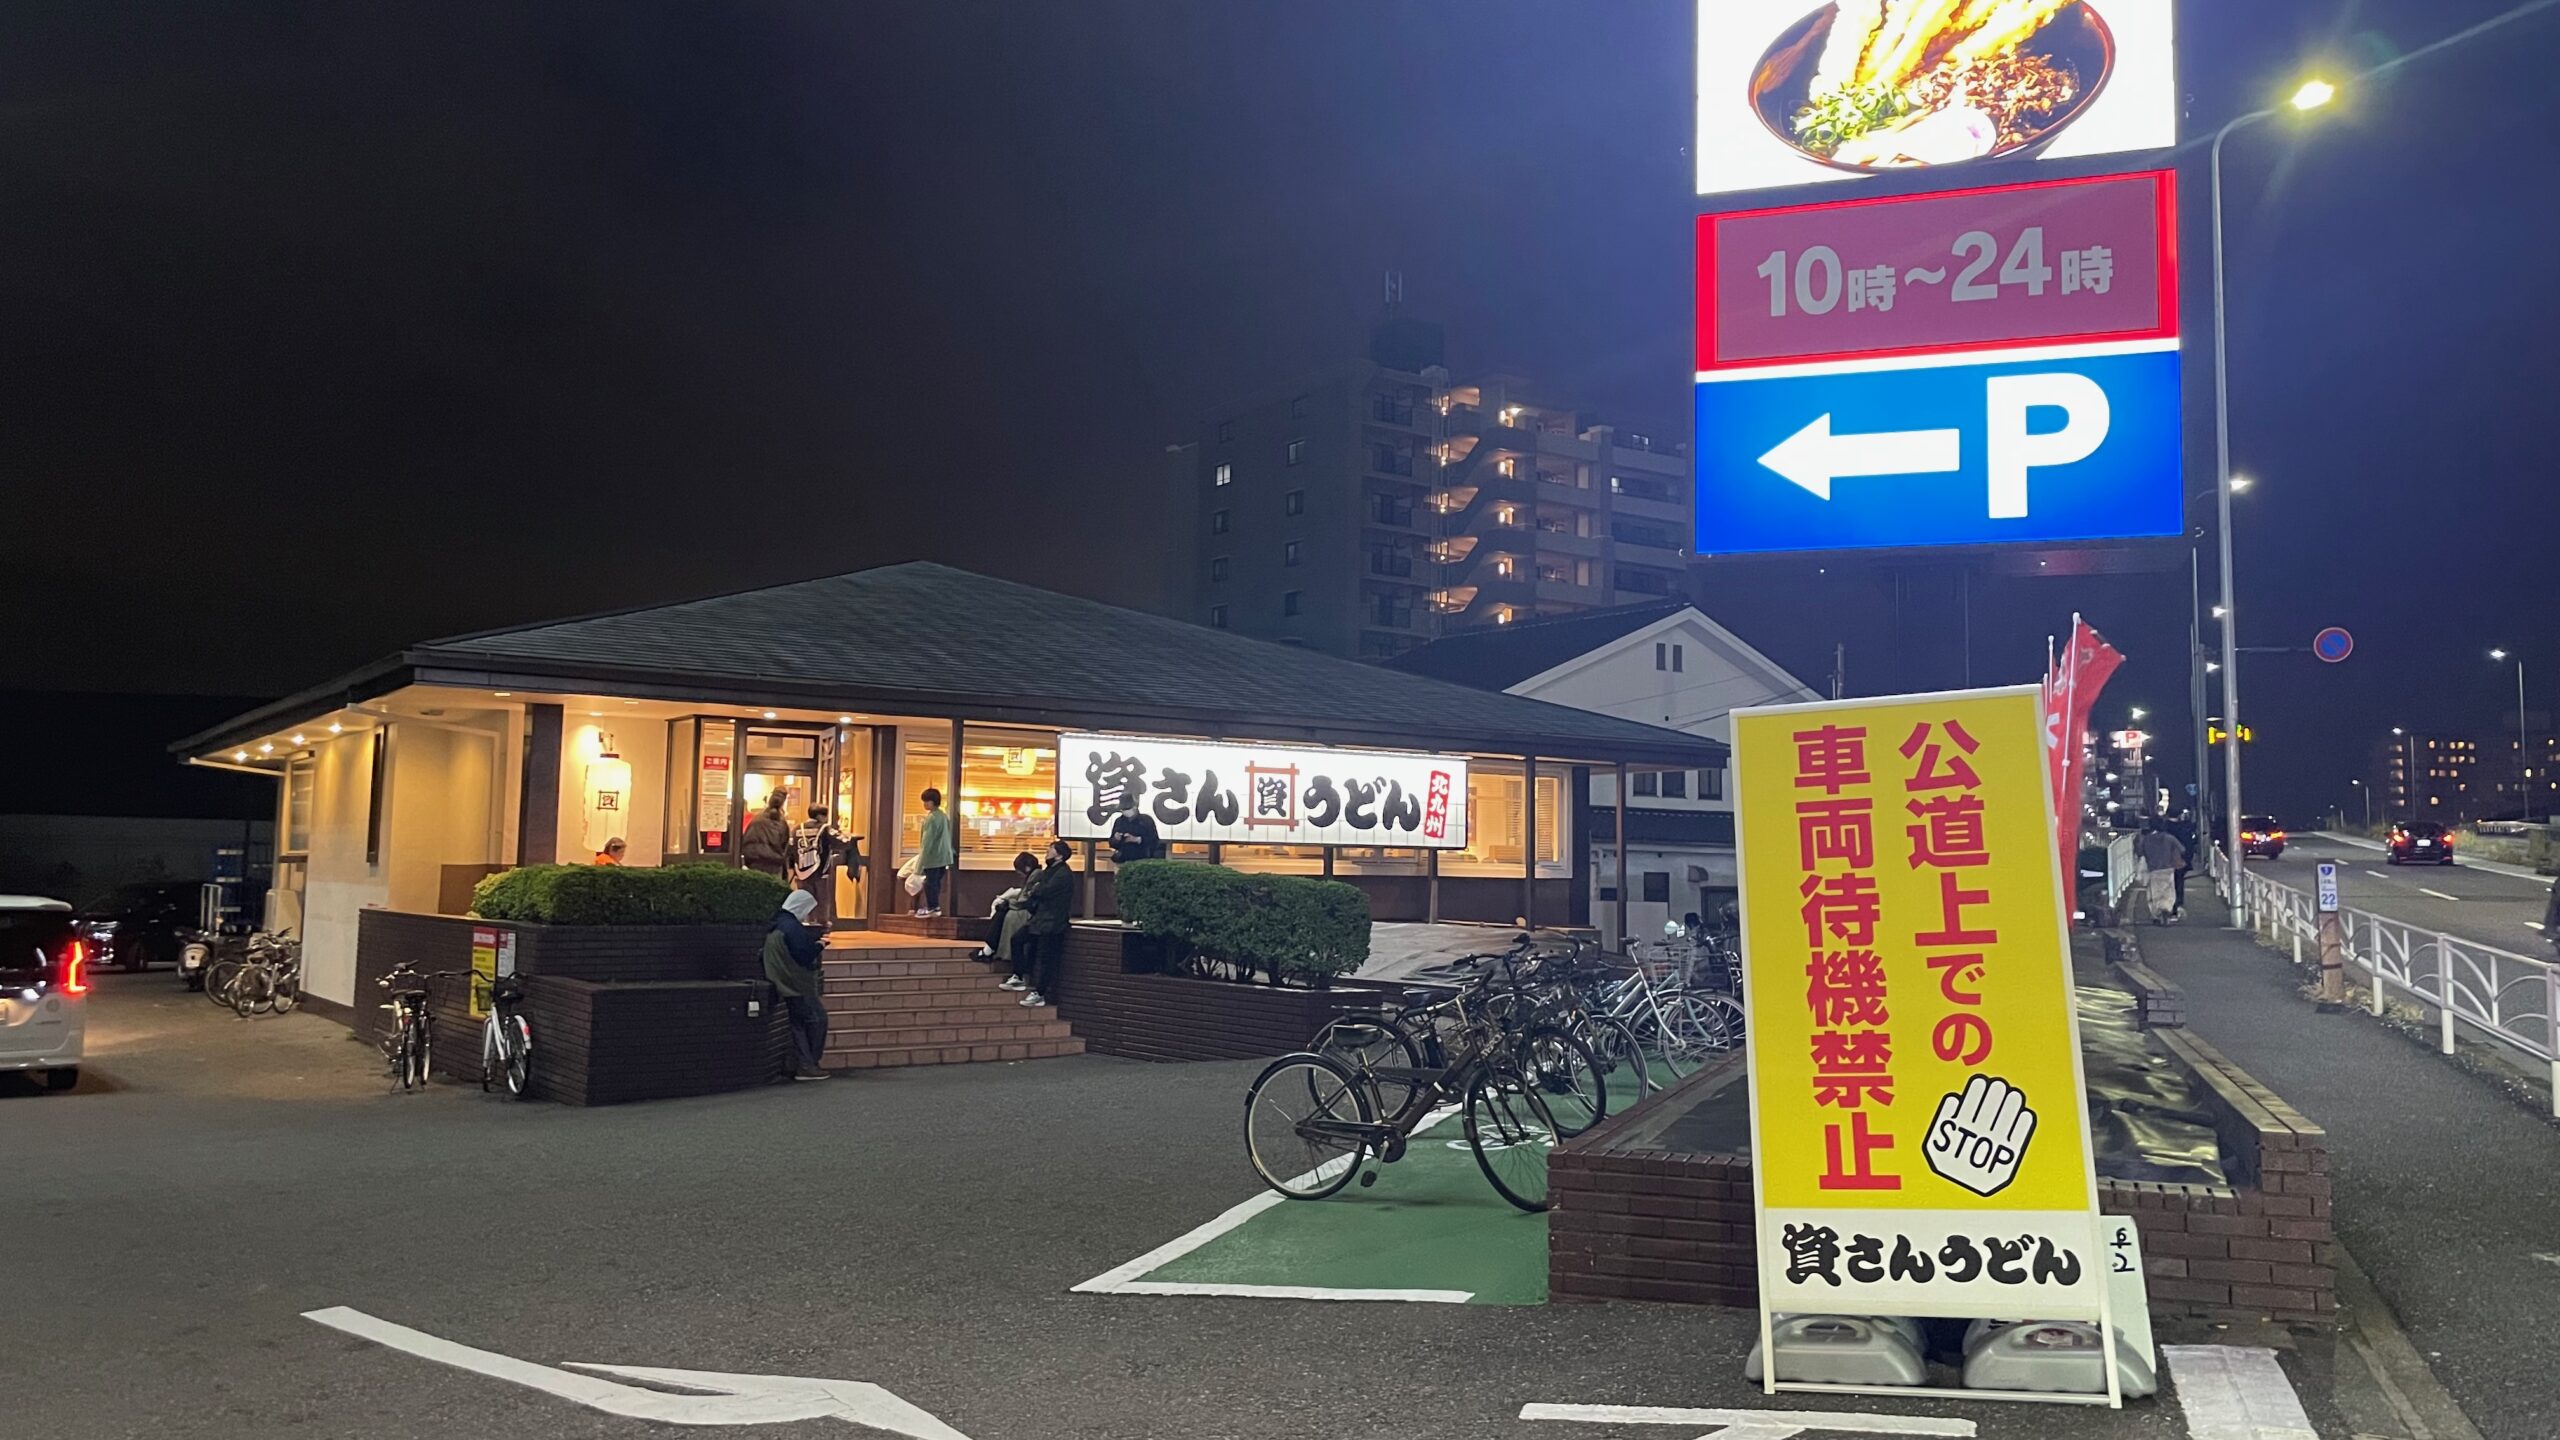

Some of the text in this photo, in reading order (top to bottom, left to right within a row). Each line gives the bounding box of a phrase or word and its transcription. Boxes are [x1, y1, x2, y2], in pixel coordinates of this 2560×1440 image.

[1987, 373, 2110, 519] P
[2126, 732, 2137, 743] P
[1303, 775, 1421, 832] うどん
[1426, 774, 1448, 837] 北九州
[1898, 719, 1997, 1066] 公道上での
[2322, 893, 2336, 905] 22
[1793, 725, 1901, 1190] 車両待機禁止
[1933, 1120, 2015, 1173] STOP
[1782, 1223, 2081, 1287] 資さんうどん
